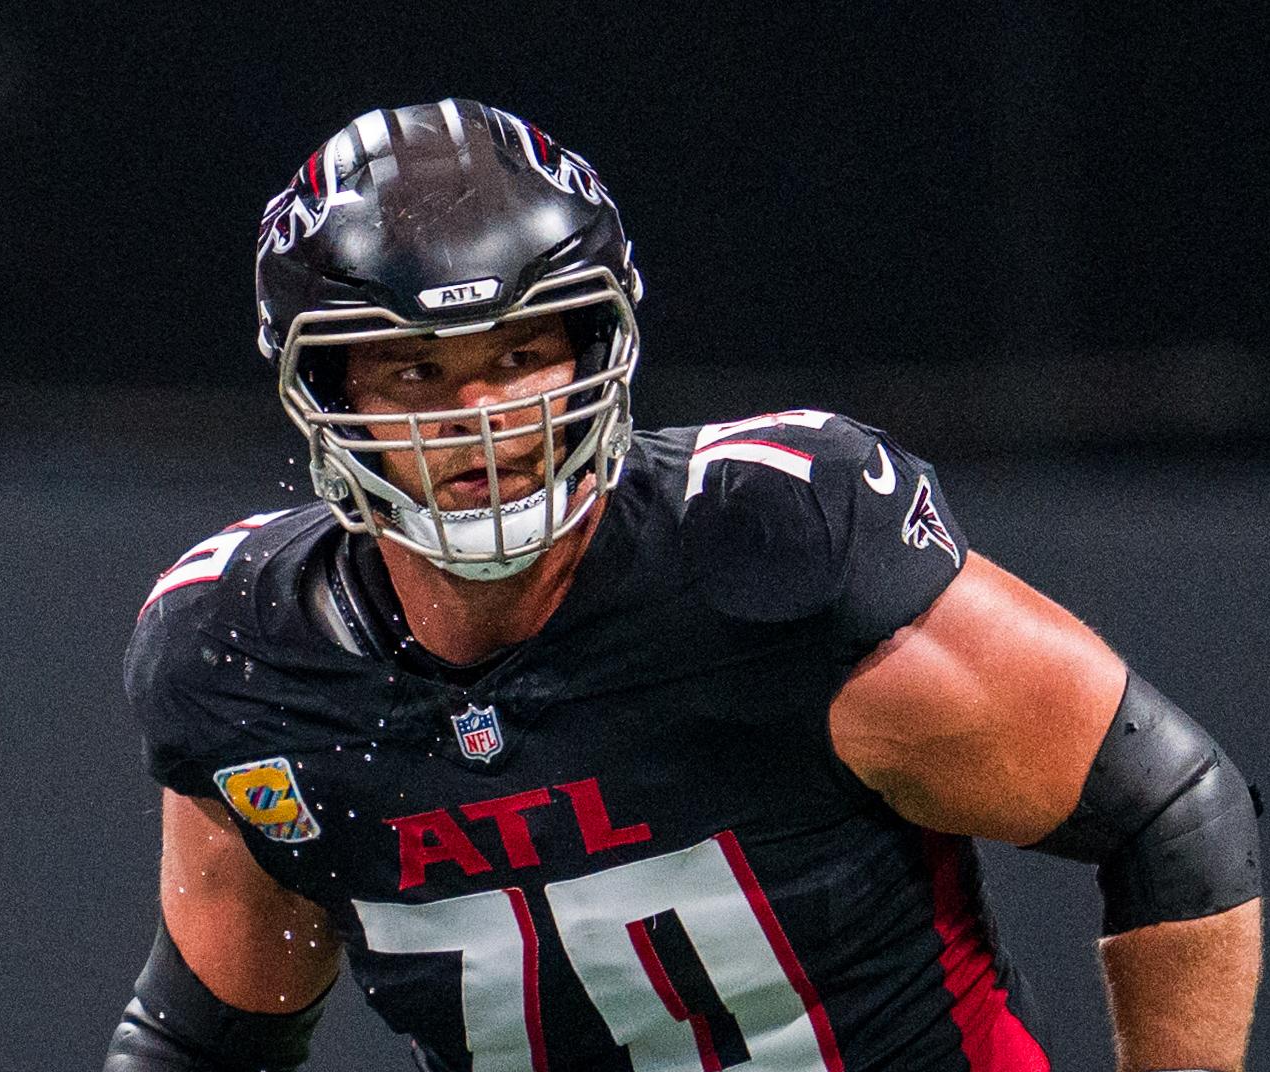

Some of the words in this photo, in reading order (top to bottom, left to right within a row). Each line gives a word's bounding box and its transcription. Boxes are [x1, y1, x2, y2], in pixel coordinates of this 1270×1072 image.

[438, 286, 482, 304] ATL
[465, 730, 497, 754] NFL
[226, 767, 298, 825] C
[382, 777, 652, 891] ATL
